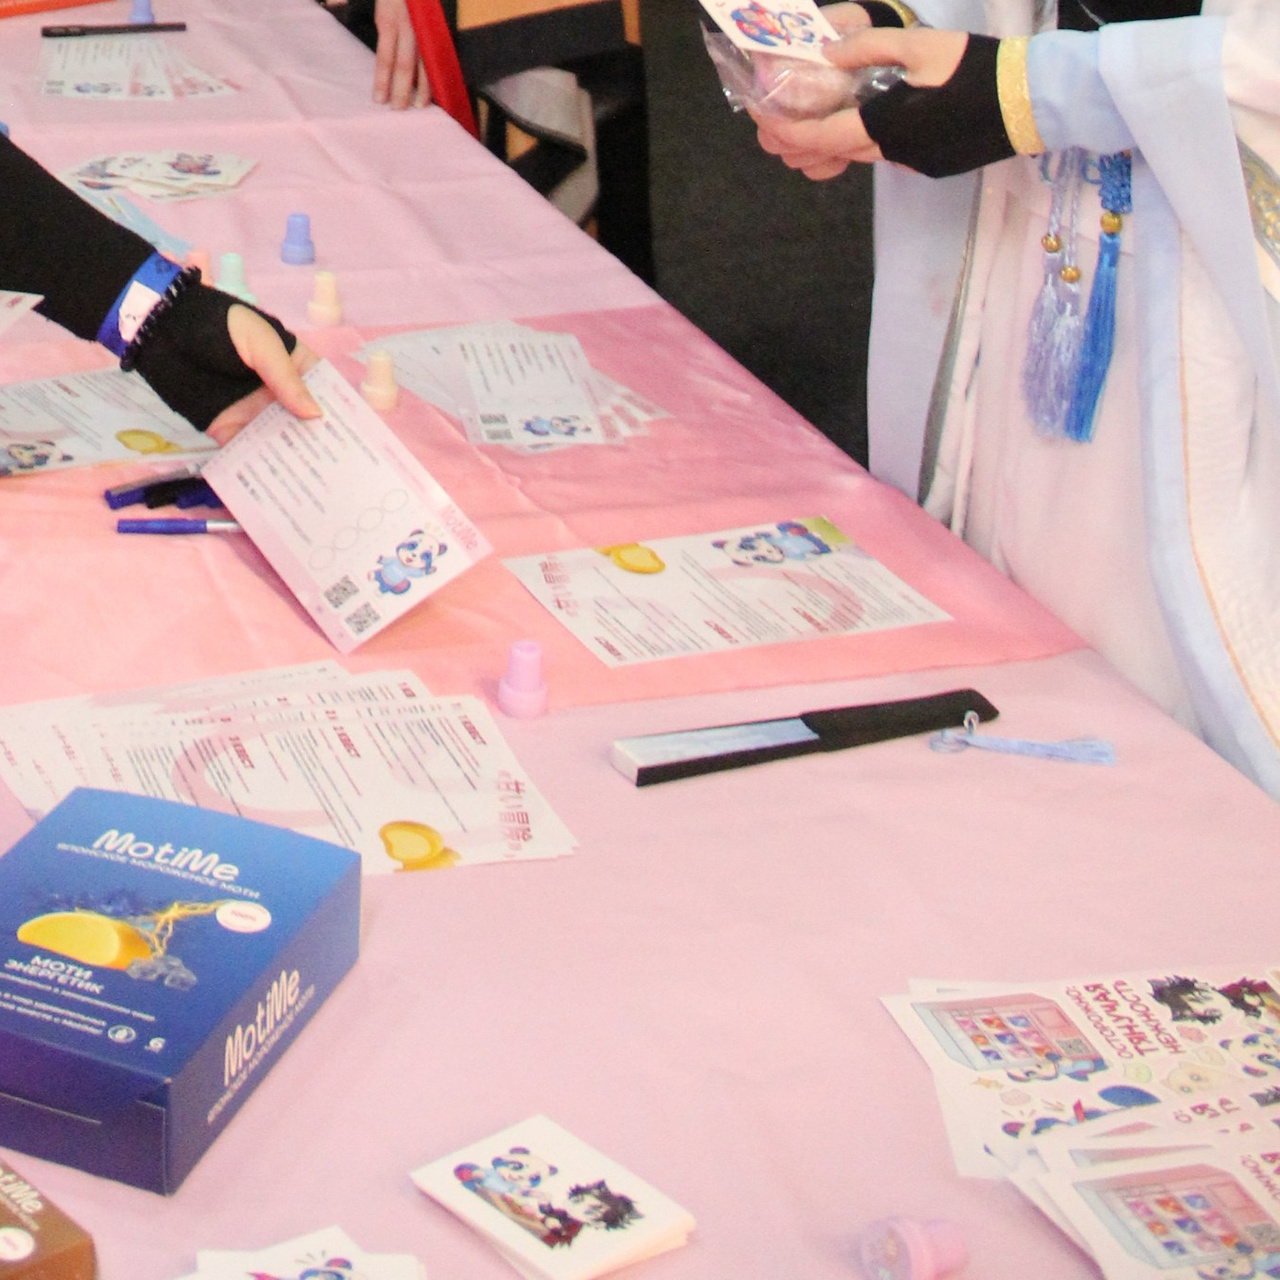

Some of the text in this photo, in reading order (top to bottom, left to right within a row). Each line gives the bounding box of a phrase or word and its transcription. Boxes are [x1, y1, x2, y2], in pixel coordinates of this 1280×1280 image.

[93, 829, 239, 882] MotiMe
[4, 959, 104, 995] ЭНЕРГЕТИК
[31, 955, 93, 981] МОТИ
[224, 969, 300, 1087] MotiMe
